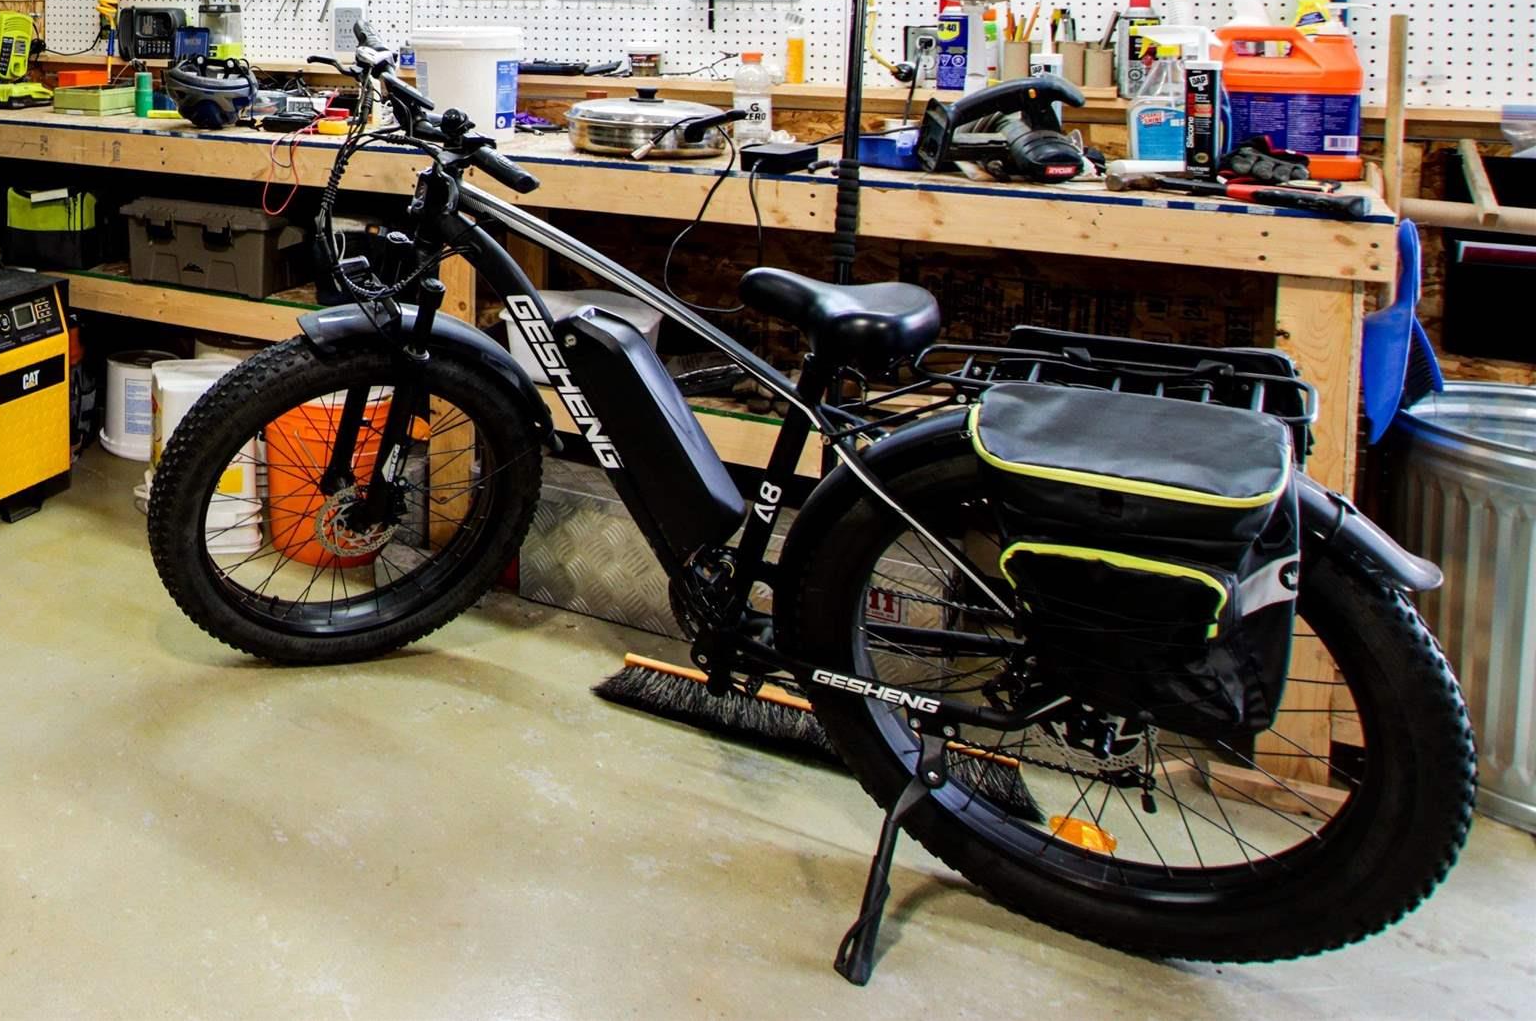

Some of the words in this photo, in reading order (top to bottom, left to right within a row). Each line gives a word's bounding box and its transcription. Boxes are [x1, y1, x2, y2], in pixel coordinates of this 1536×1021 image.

[750, 103, 760, 112] G
[22, 369, 41, 390] CAT
[506, 294, 625, 469] GESHENG
[812, 669, 940, 714] GESHENG
